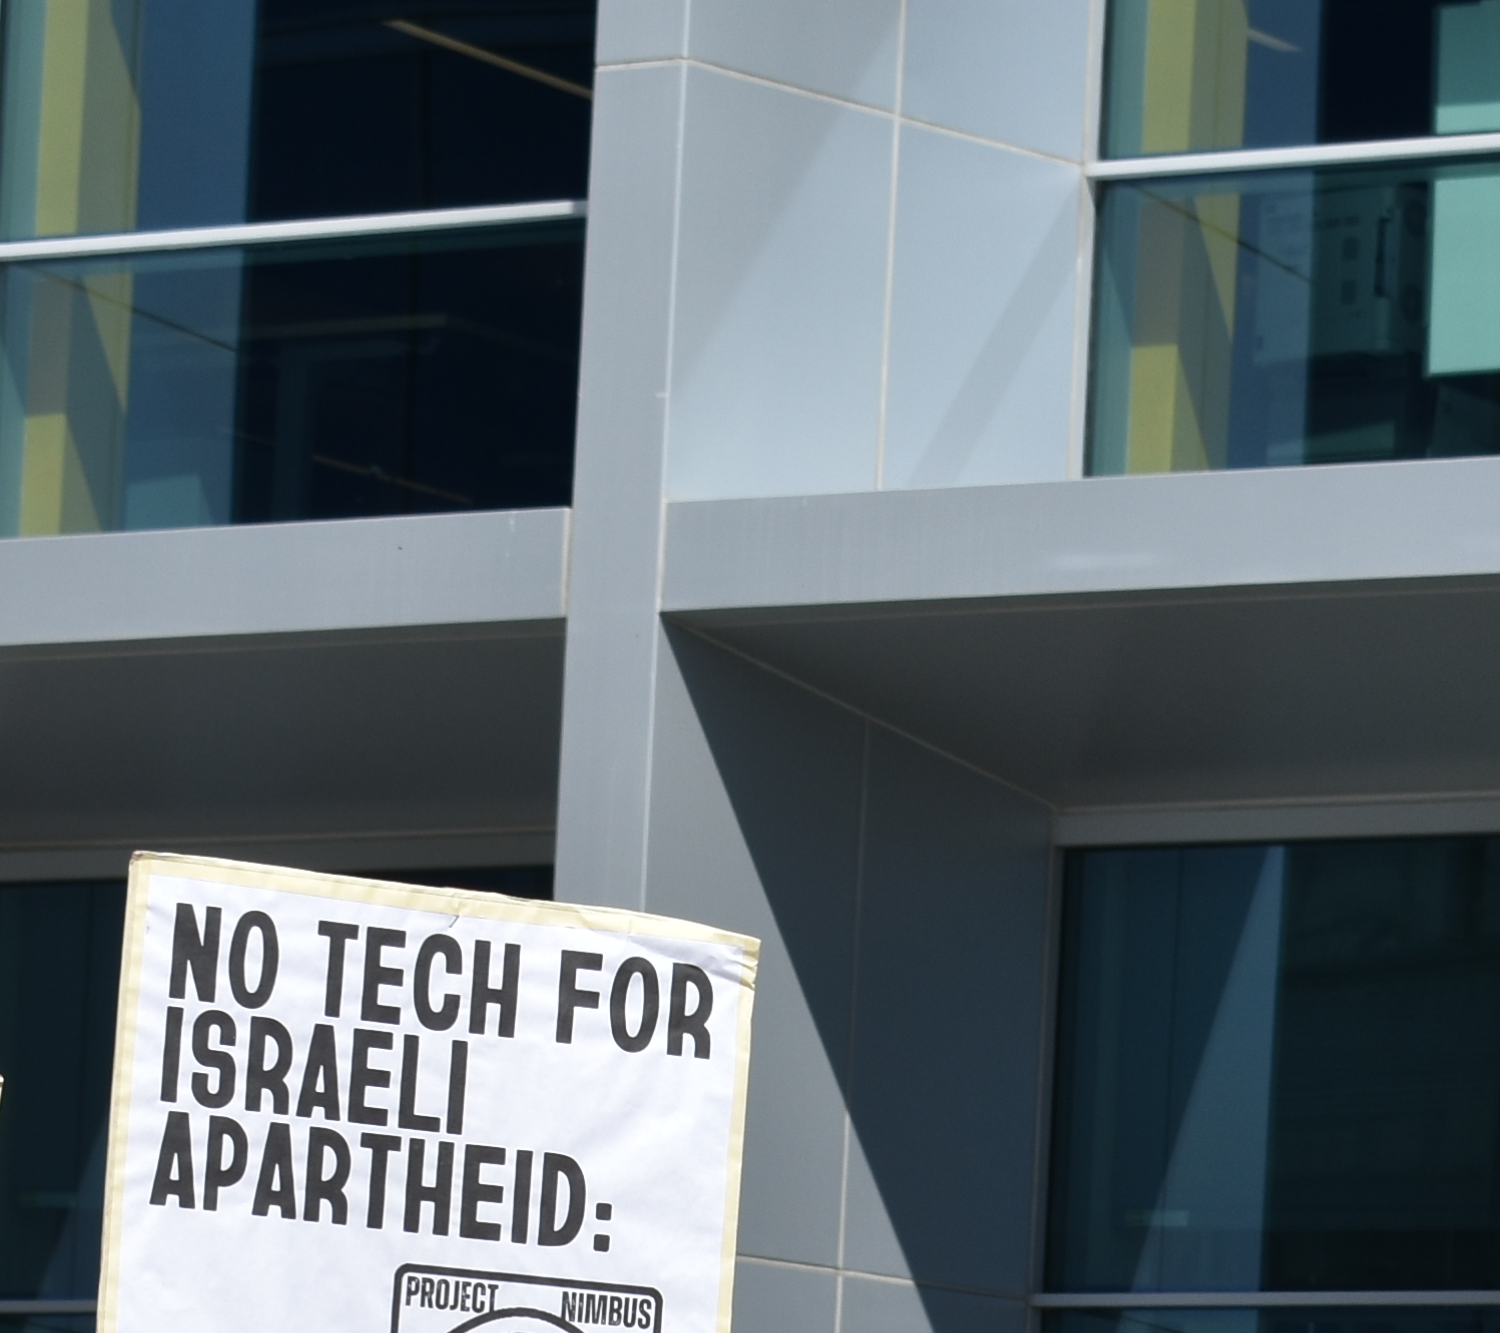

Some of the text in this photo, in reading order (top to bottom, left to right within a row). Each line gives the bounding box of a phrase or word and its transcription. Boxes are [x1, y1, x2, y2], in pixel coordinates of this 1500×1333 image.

[168, 902, 715, 1060] NO TECH FOR
[159, 1009, 470, 1135] ISRAELI
[149, 1111, 613, 1252] APARTHEID:
[405, 1275, 653, 1331] PROJECT NIMBUS
